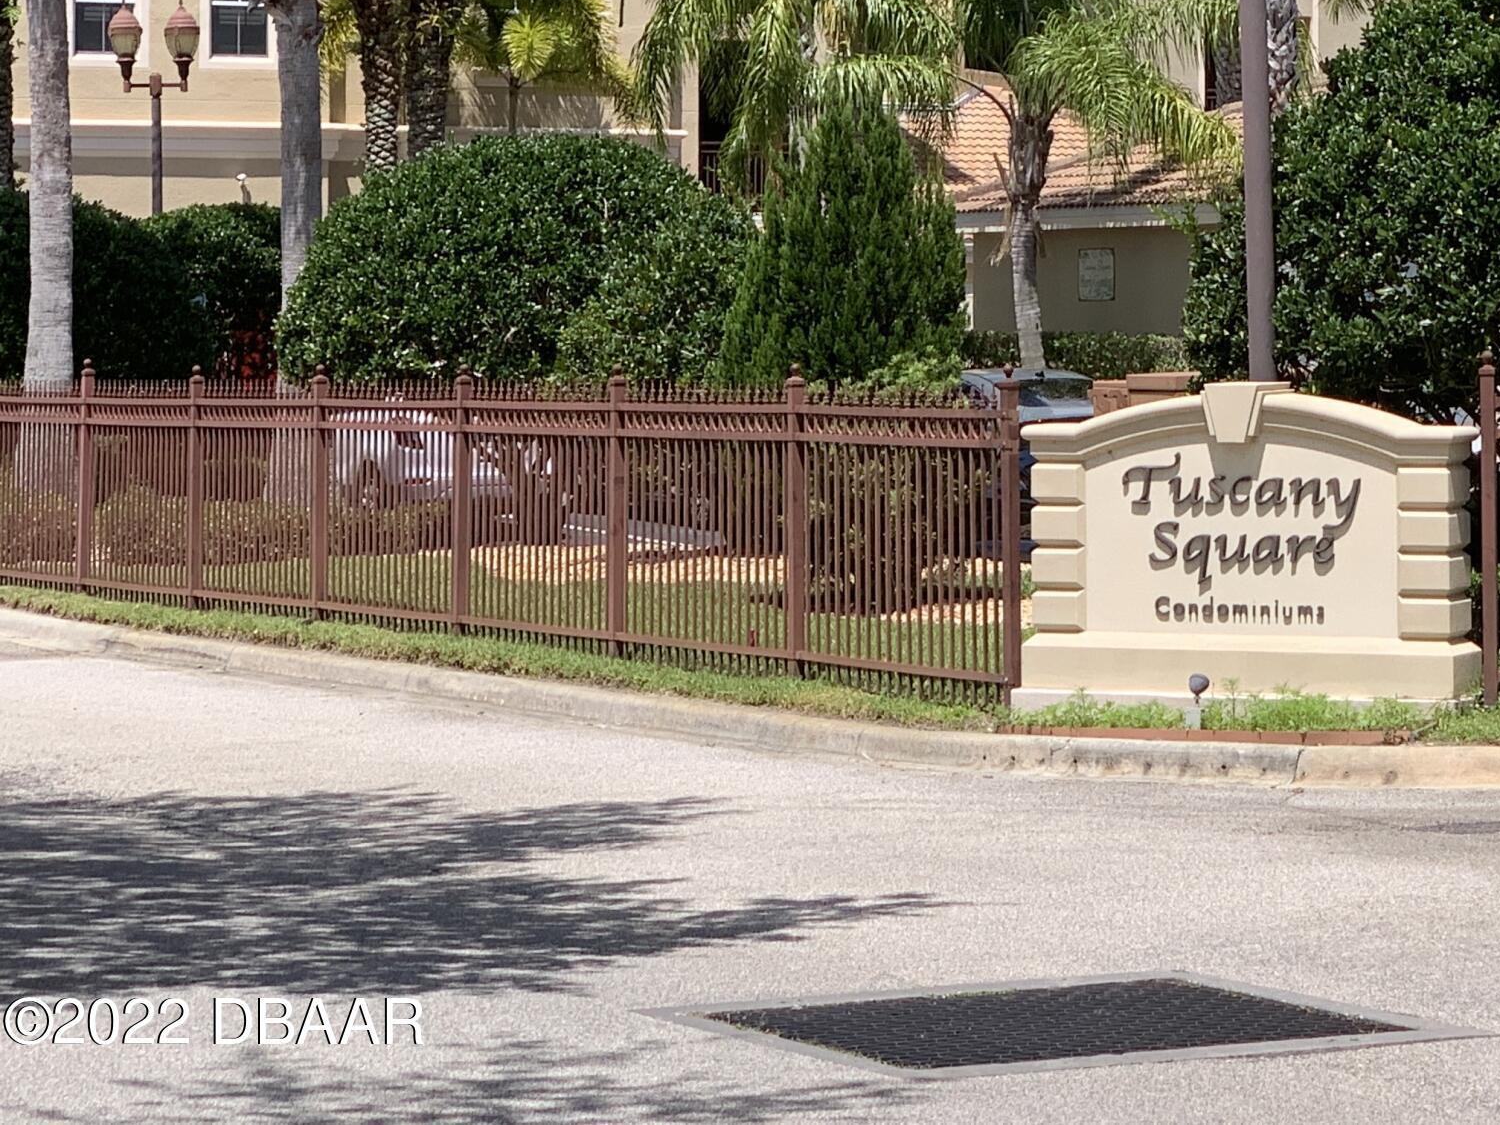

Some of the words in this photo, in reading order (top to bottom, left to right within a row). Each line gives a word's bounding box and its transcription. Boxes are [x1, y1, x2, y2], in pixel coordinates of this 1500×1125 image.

[1122, 452, 1361, 537] Tuscany
[1148, 521, 1336, 593] Square
[1154, 596, 1325, 625] Condominiums
